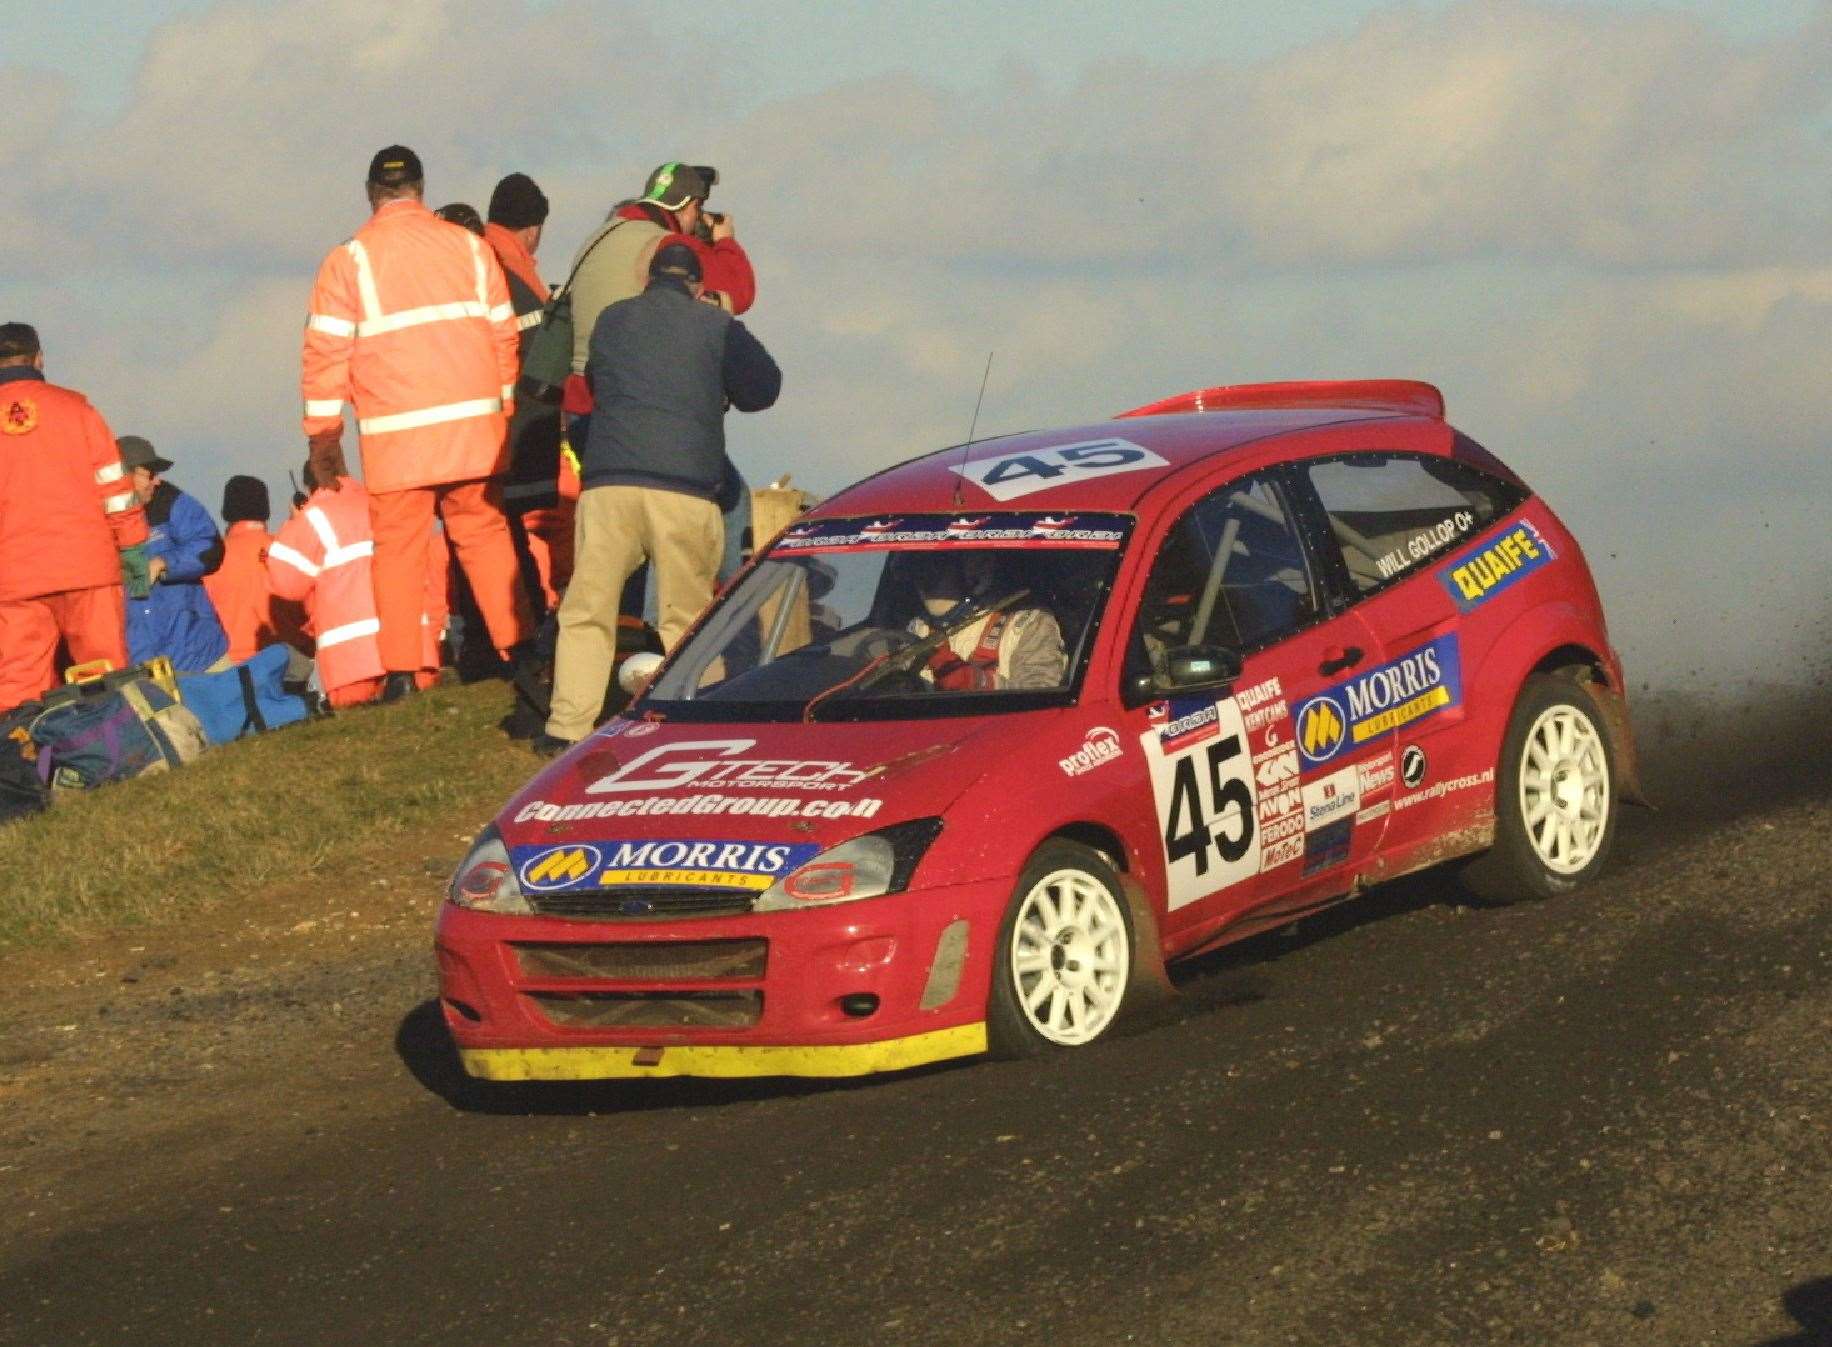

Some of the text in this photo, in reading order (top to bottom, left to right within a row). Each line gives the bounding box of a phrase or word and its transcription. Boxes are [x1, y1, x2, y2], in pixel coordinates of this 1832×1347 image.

[981, 440, 1145, 486] 45
[1376, 548, 1411, 578] WILL
[1407, 518, 1455, 558] GOLLOP
[1452, 528, 1540, 600] QUAIFE
[1345, 647, 1441, 722] MORRIS
[685, 779, 855, 791] MOTORSPORT
[1165, 734, 1254, 877] 45
[607, 841, 791, 873] MORRIS
[623, 870, 750, 887] LUBRICANTS
